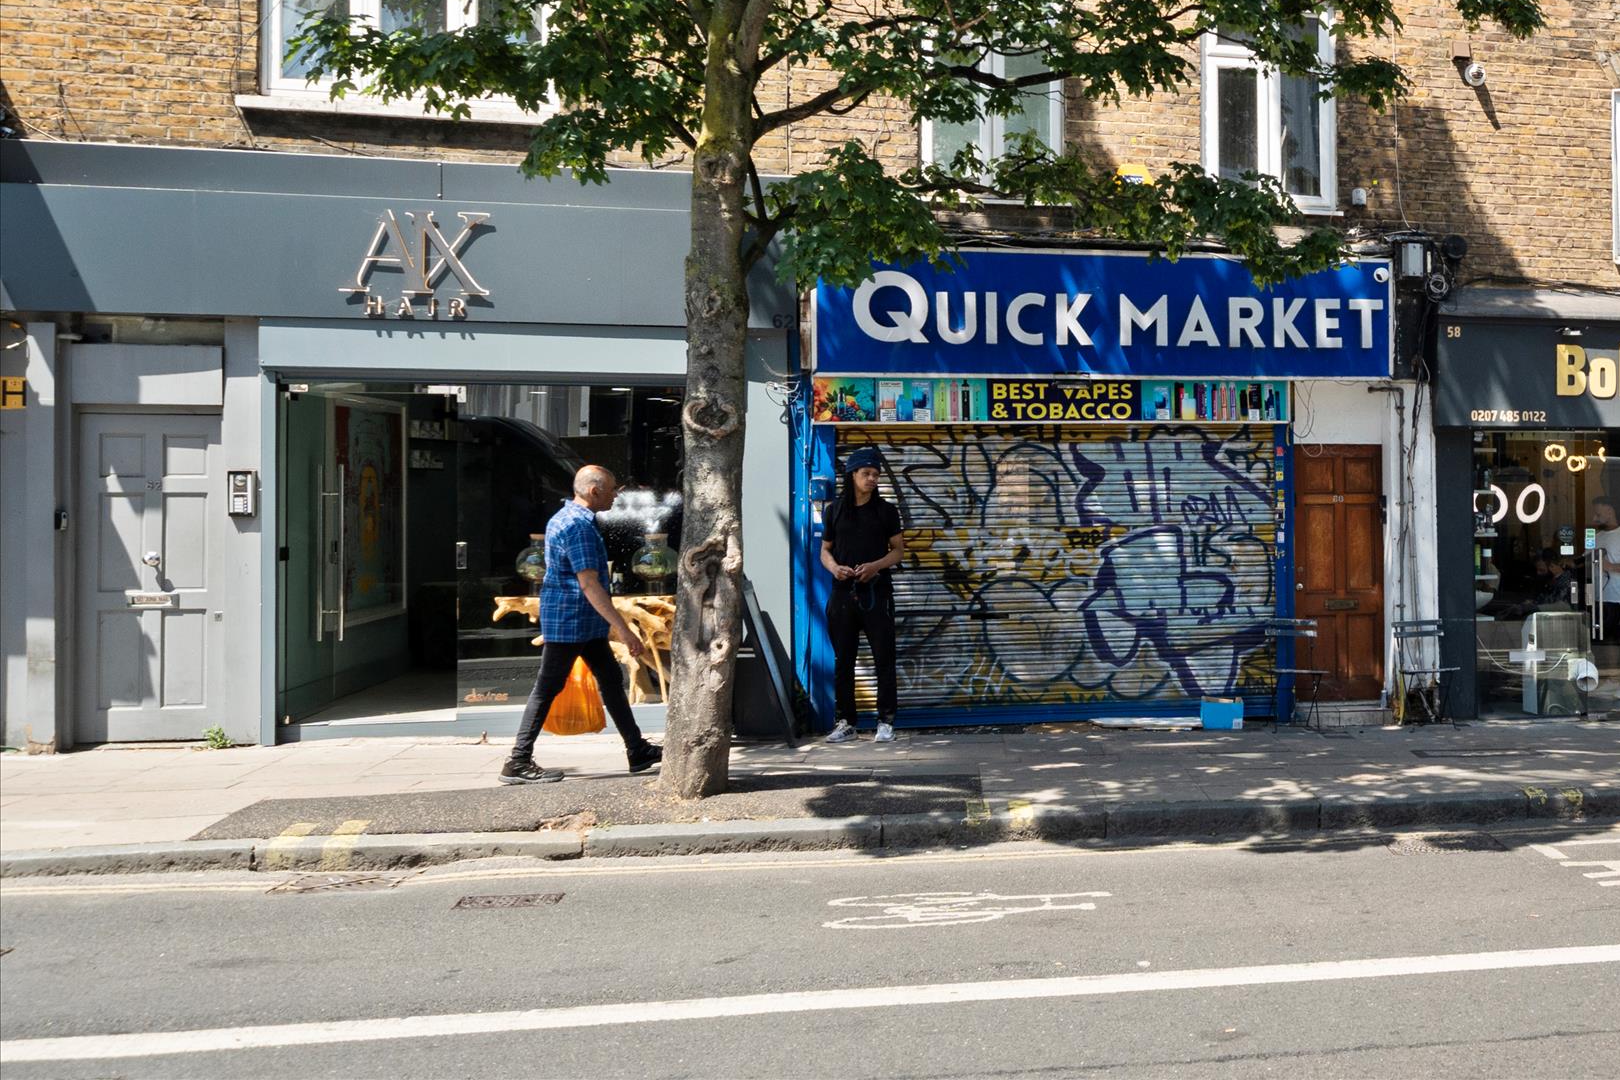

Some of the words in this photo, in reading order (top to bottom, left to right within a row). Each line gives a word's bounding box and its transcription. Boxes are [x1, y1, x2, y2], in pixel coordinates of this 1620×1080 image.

[364, 296, 466, 317] HAIR
[852, 270, 1095, 346] QUICK
[1119, 293, 1384, 350] MARKET
[772, 314, 795, 329] 62
[1447, 326, 1462, 339] 58
[2, 380, 26, 407] H
[992, 383, 1049, 401] BEST
[992, 403, 1009, 420] &
[1012, 402, 1133, 420] TOBACCO
[1471, 409, 1497, 423] 0207
[1500, 409, 1520, 423] 485
[1522, 410, 1547, 423] 0122
[145, 480, 162, 491] 62
